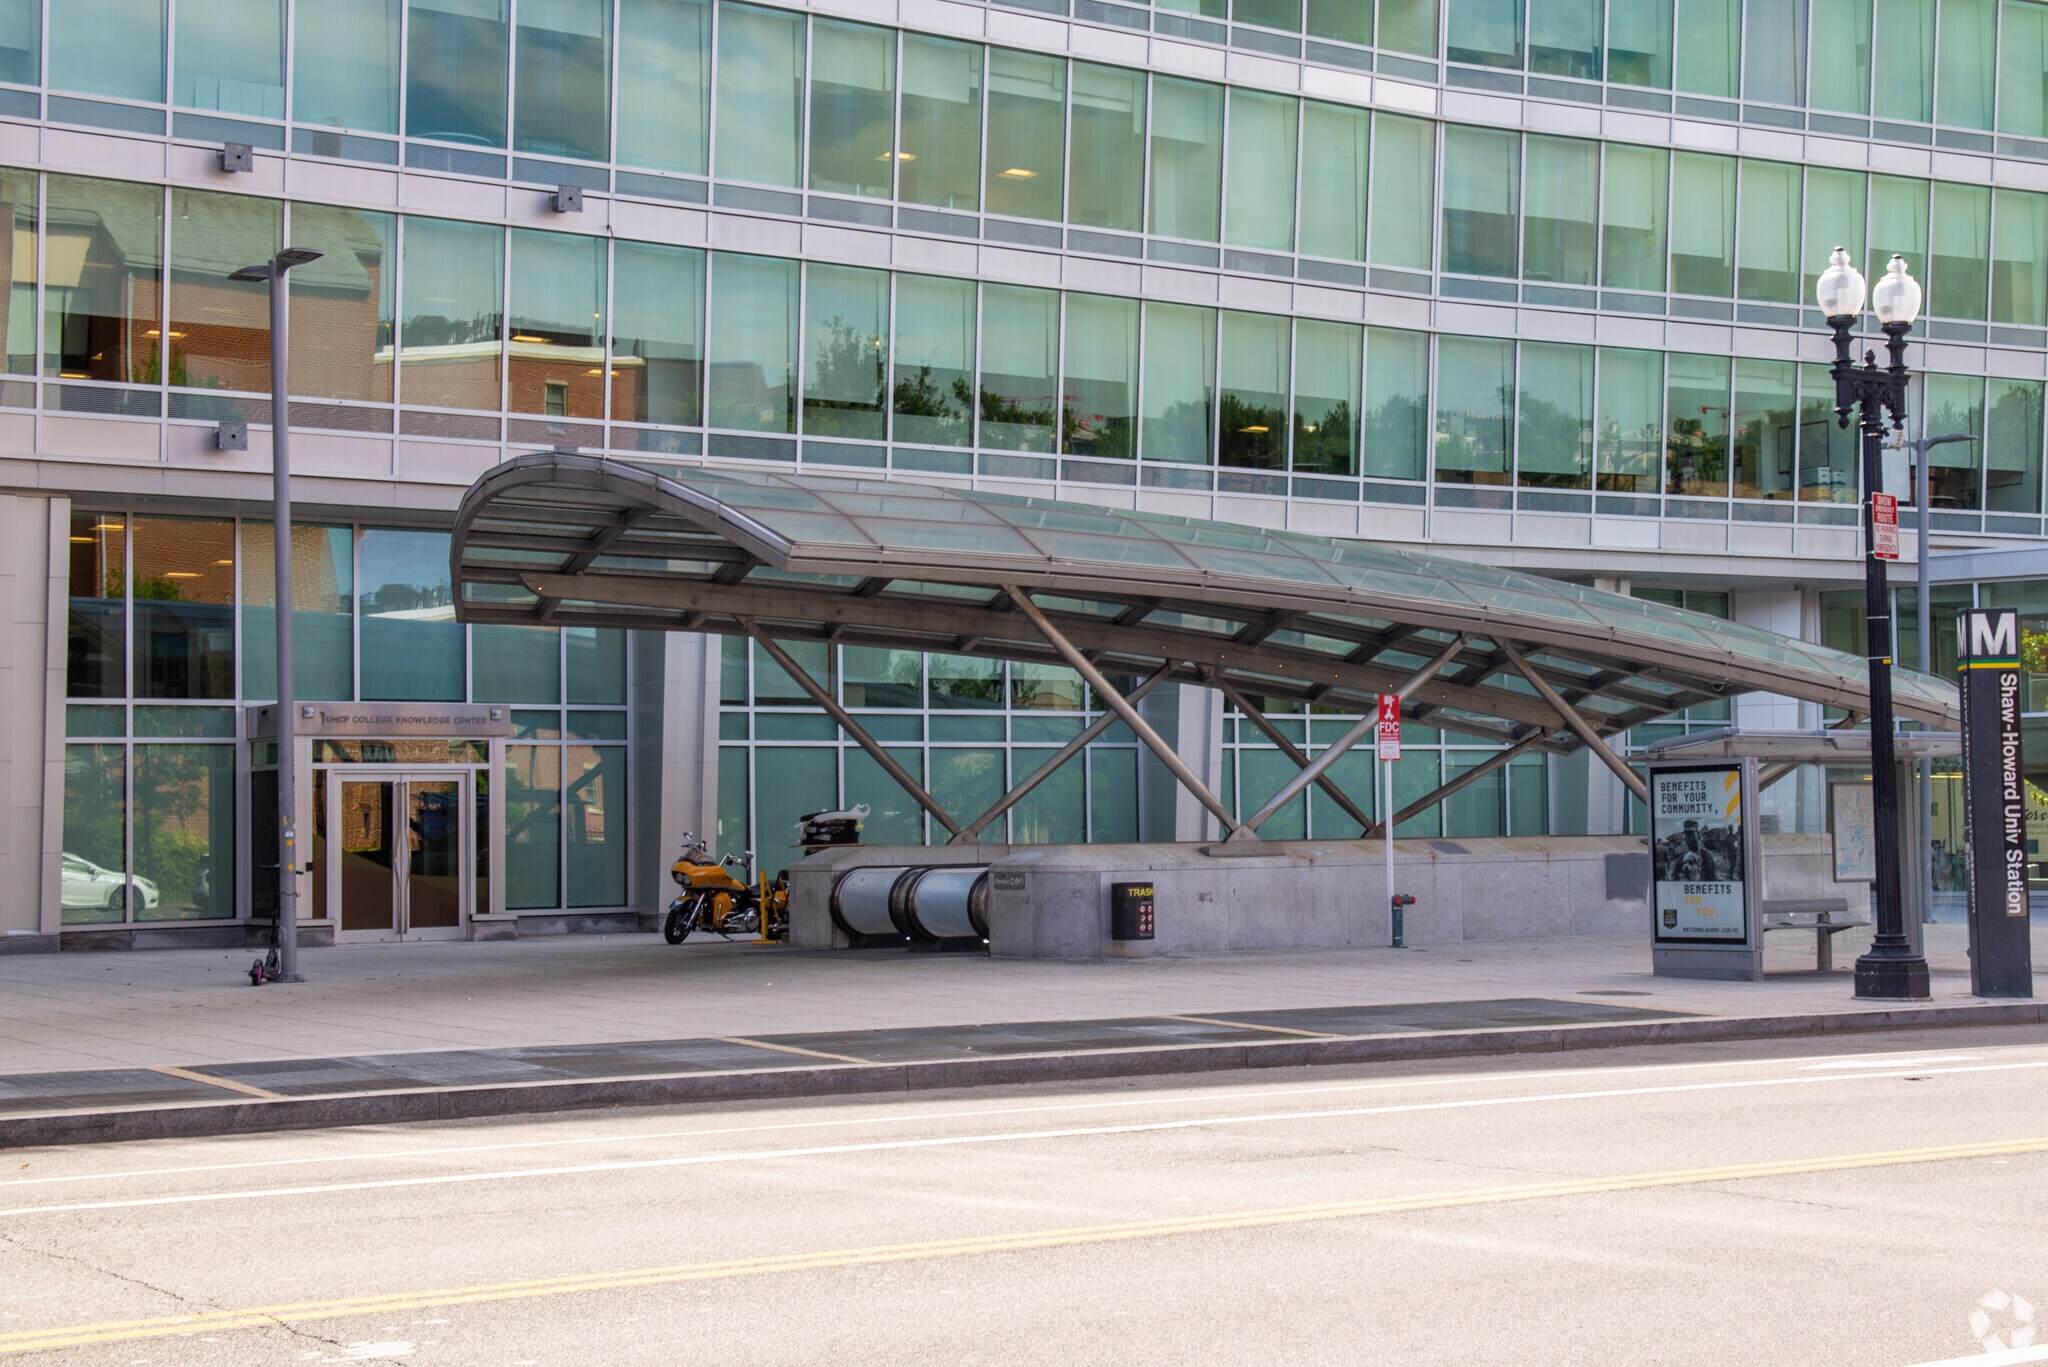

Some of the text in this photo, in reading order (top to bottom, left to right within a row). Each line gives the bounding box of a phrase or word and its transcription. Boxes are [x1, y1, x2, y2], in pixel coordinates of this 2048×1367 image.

[1877, 495, 1892, 506] SNOW
[1875, 505, 1895, 513] EMERGENCY
[1877, 513, 1893, 524] ROUTE
[1971, 612, 2017, 656] M
[352, 716, 393, 724] COLLEGE
[396, 717, 451, 725] KNOWLEDGE
[453, 717, 487, 725] CENTER
[1379, 722, 1400, 732] FDC
[1660, 781, 1707, 792] BENEFITS
[1661, 792, 1707, 803] FOR YOUR
[2000, 673, 2024, 914] Shaw-Howard Univ Station
[1661, 803, 1718, 815] COMMUNITY,
[1684, 884, 1732, 895] BENEFITS
[1684, 895, 1702, 906] FOR
[1696, 907, 1719, 917] YOU.
